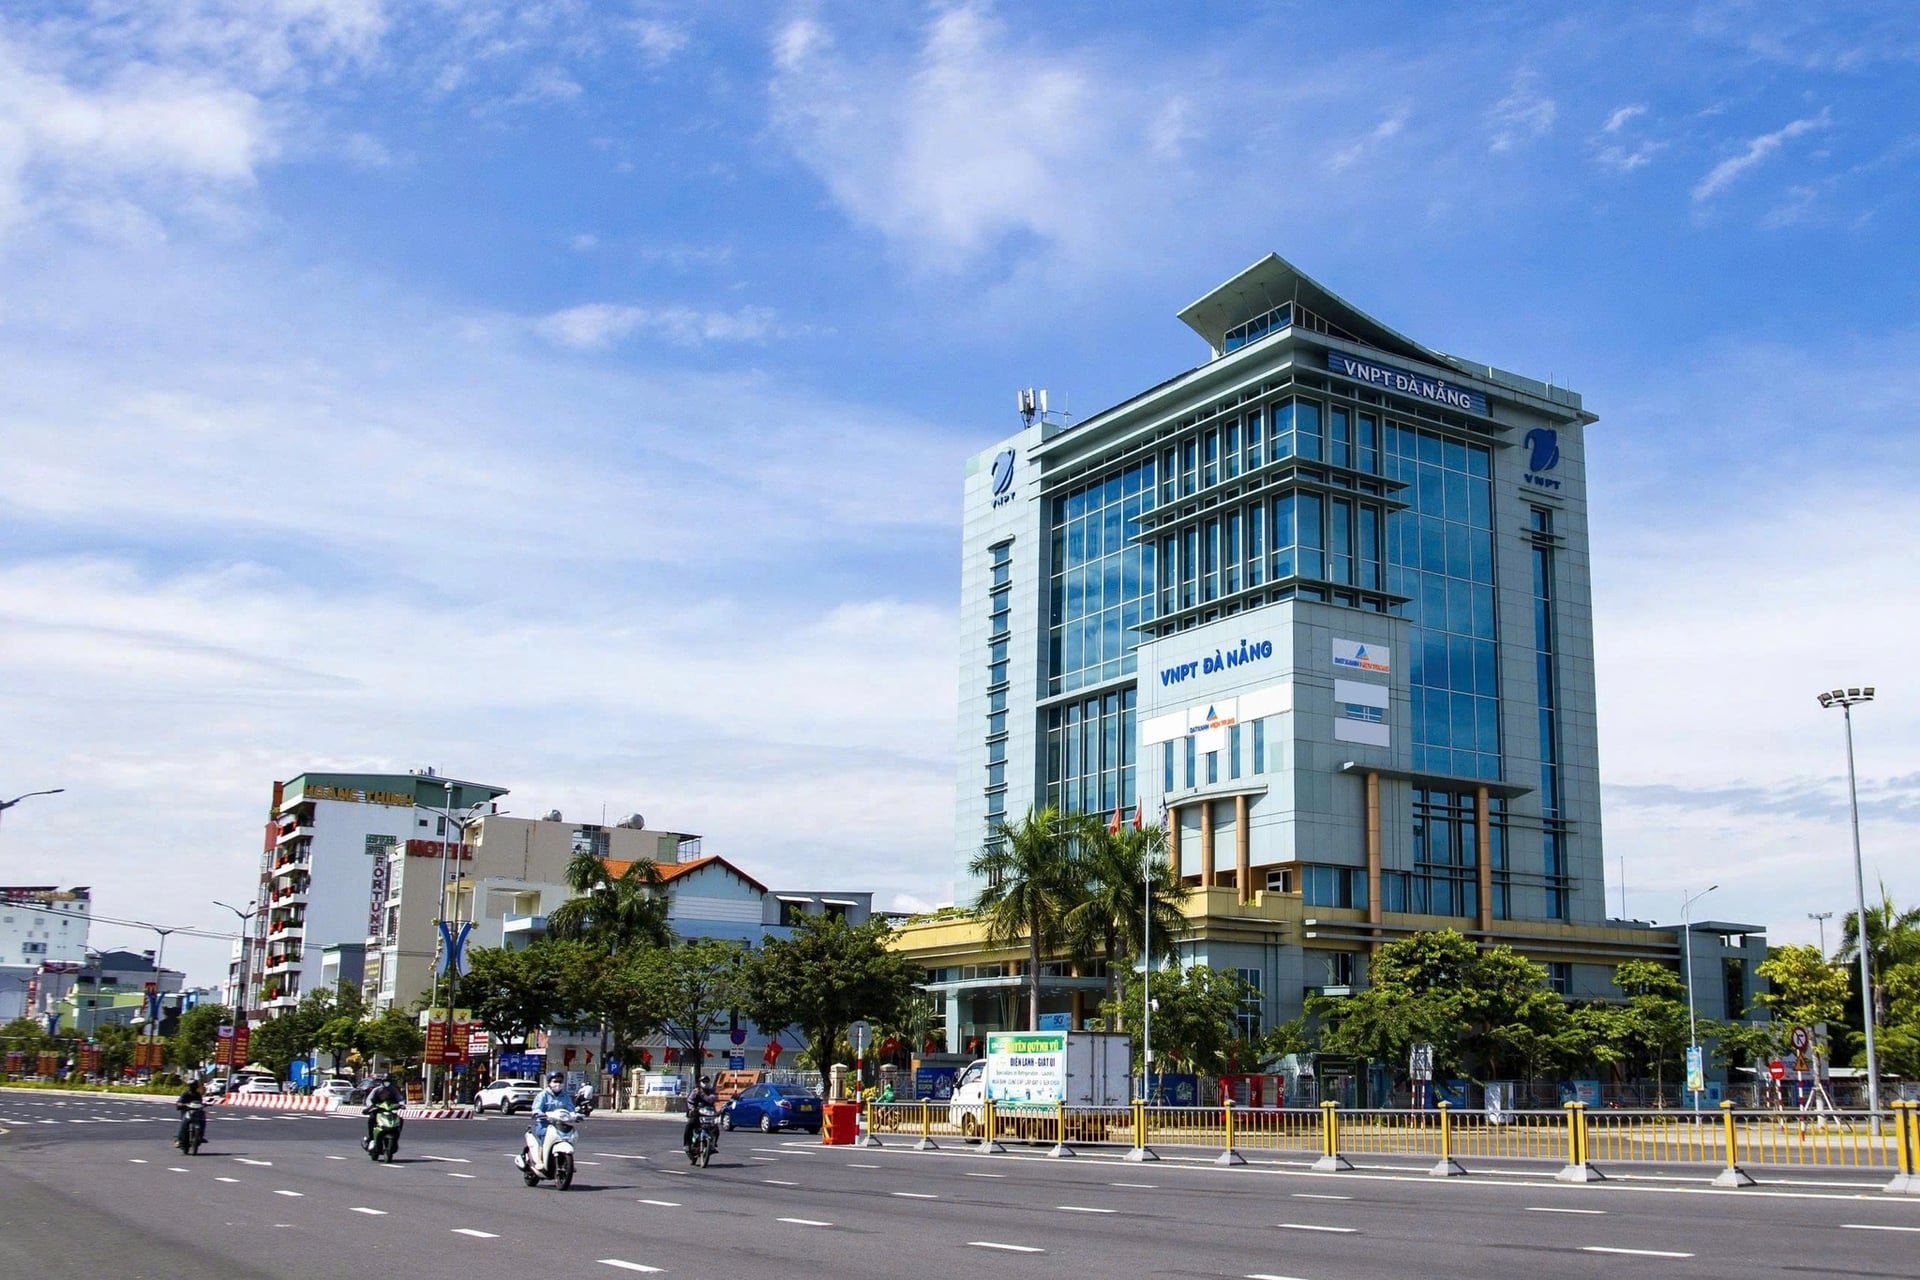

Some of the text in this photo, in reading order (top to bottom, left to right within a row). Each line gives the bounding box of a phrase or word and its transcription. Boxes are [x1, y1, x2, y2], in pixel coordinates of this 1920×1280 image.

[1344, 359, 1391, 386] VNPT
[1396, 374, 1420, 396] ĐÀ
[1524, 473, 1561, 490] VNPT
[991, 491, 1016, 509] VNPT
[1161, 661, 1198, 686] VNPT
[1203, 649, 1224, 675] ĐÀ
[370, 856, 384, 936] FORTUNE
[611, 1064, 617, 1074] P
